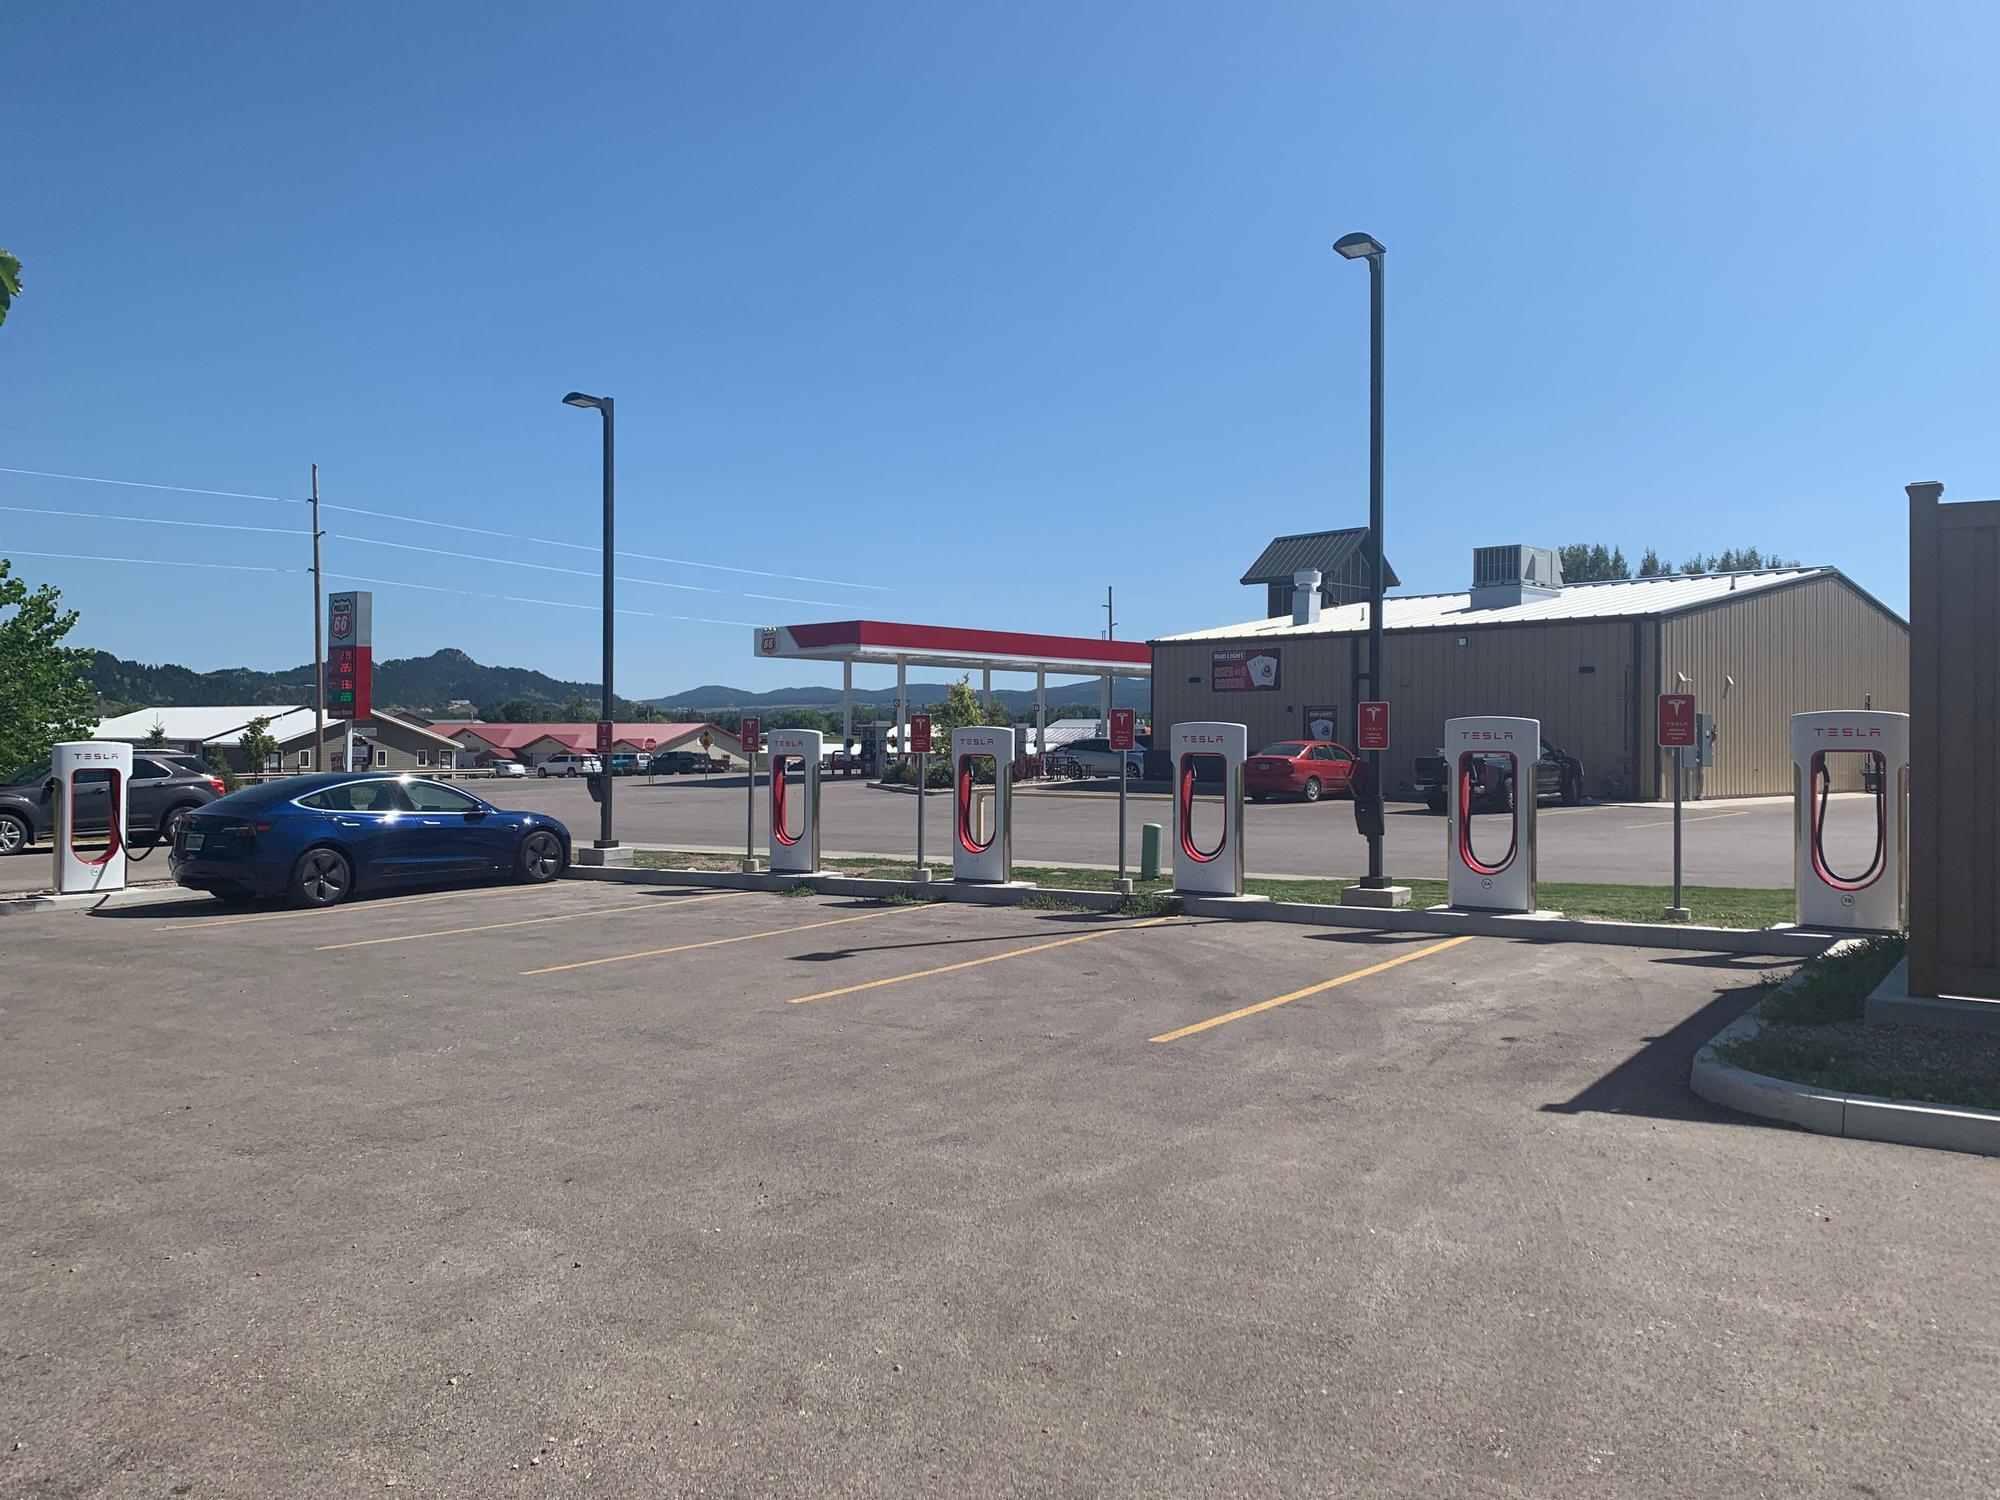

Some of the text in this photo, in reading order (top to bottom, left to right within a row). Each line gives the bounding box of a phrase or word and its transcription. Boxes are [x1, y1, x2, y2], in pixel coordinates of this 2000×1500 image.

[333, 615, 348, 631] 66
[764, 638, 774, 649] 66
[1227, 652, 1244, 660] LIGHT
[1461, 731, 1513, 740] TESLA
[1813, 728, 1880, 737] TESLA
[960, 738, 994, 746] TESLA
[1182, 735, 1224, 743] TESLA
